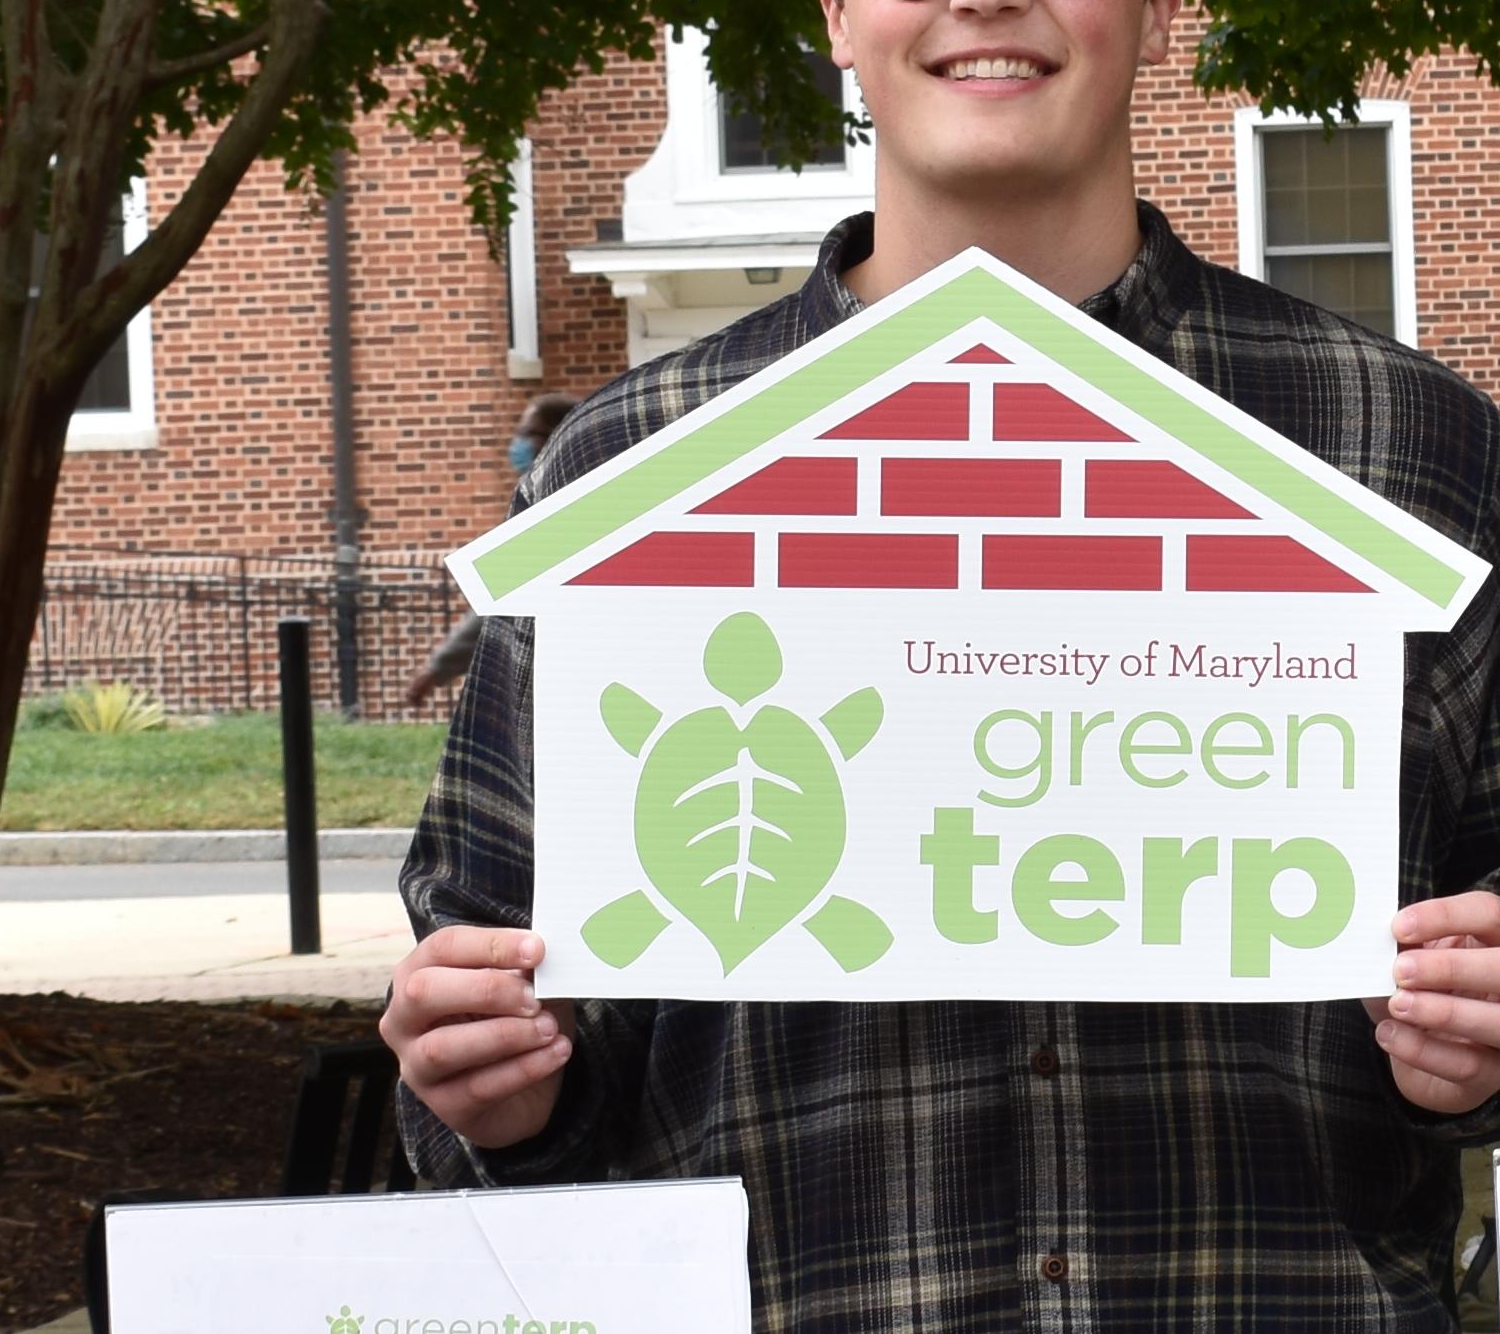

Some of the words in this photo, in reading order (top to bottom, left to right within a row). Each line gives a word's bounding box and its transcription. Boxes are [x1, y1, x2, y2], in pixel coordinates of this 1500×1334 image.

[904, 640, 1108, 685] University
[1118, 640, 1159, 679] of
[1167, 643, 1357, 687] Maryland
[972, 707, 1356, 809] green
[919, 806, 1357, 978] terp
